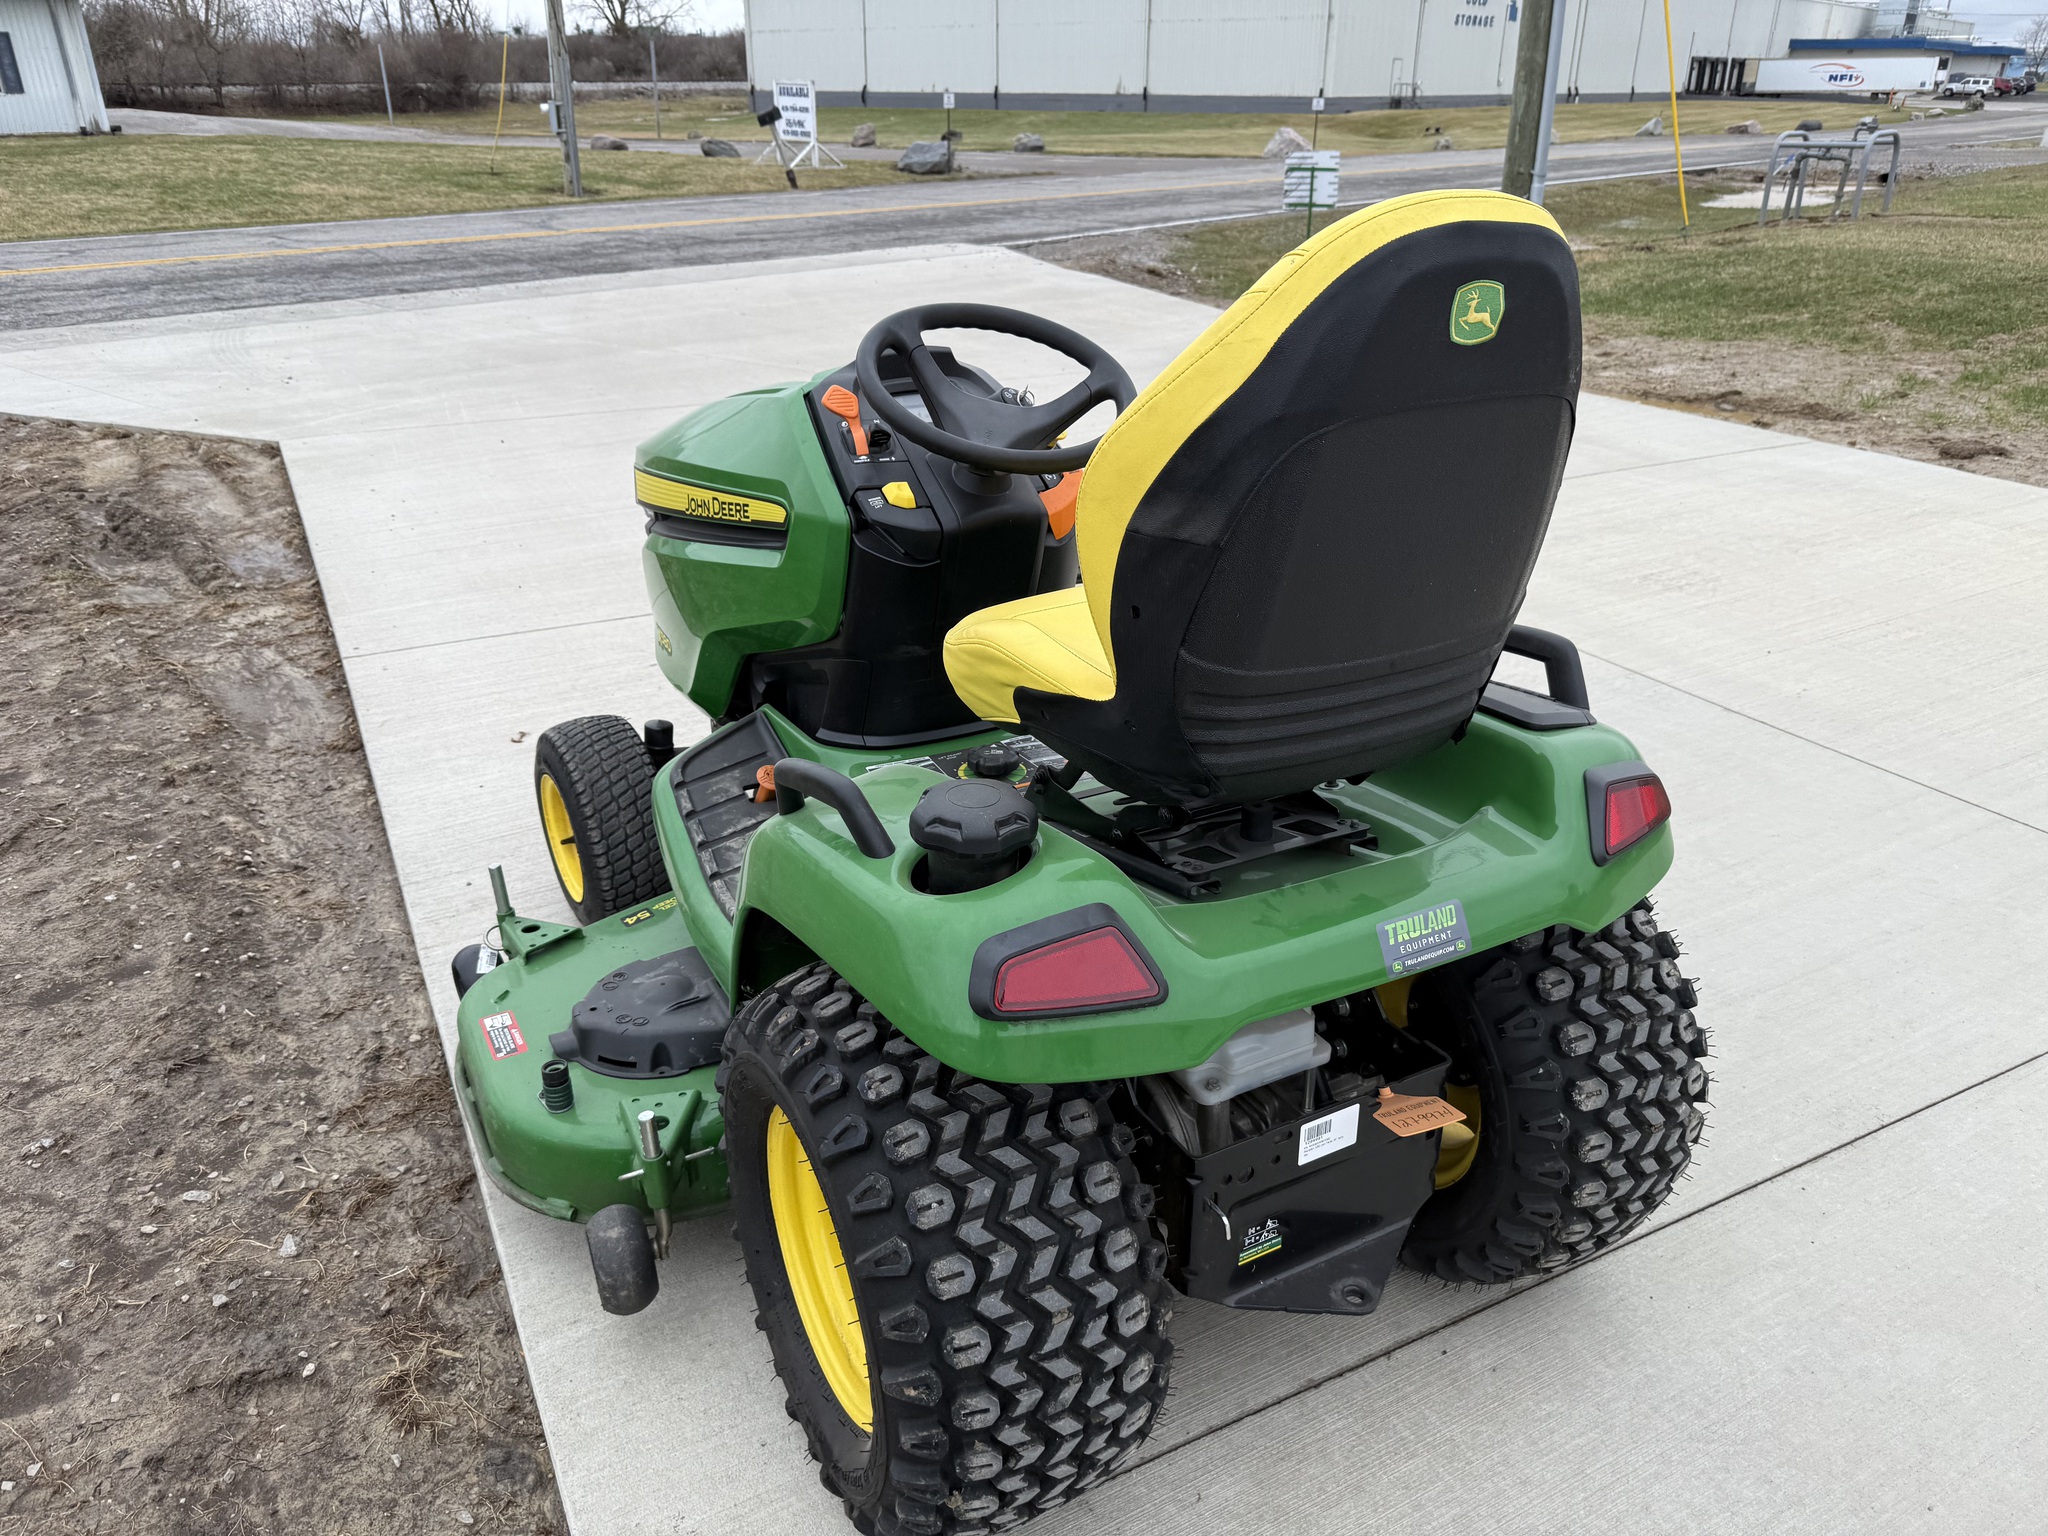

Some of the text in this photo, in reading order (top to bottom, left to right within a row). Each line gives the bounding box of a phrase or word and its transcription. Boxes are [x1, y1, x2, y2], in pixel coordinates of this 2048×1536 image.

[1454, 14, 1495, 27] STORAGE
[1828, 74, 1853, 82] NFI
[685, 493, 750, 519] JOHN DEERE
[623, 910, 651, 925] 54
[1384, 904, 1457, 945] TRULAND
[1400, 930, 1452, 954] EQUIPMENT
[1404, 945, 1455, 967] TRULANDEQUIP.COM
[1377, 1098, 1440, 1118] TRULAND EQUIPMENT
